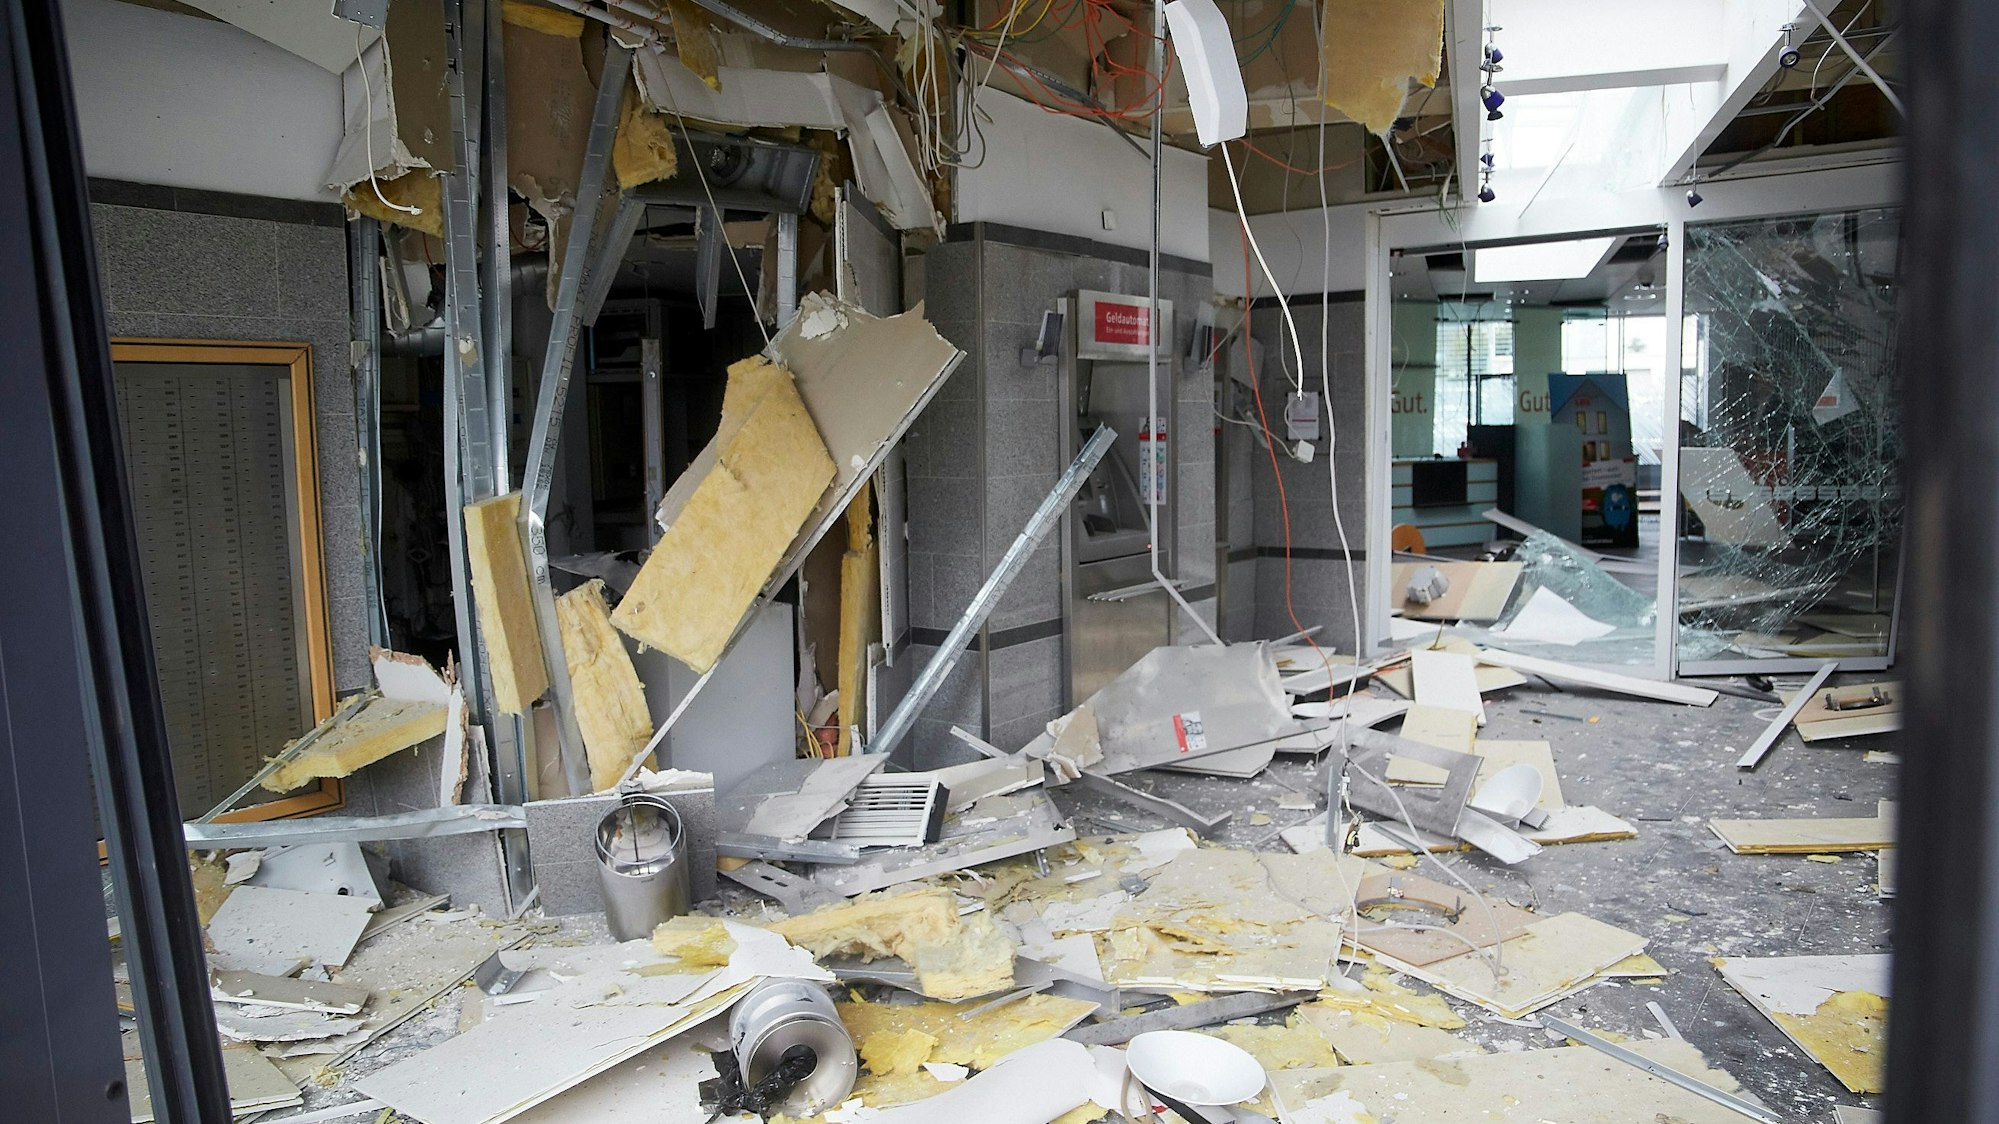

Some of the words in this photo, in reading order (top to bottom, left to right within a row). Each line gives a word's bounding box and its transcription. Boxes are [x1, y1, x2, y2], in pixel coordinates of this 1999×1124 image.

[576, 266, 591, 304] MAXI
[560, 315, 581, 373] PROFIL
[549, 386, 567, 426] 5215
[531, 526, 545, 555] 350
[536, 566, 546, 585] cm
[983, 578, 1010, 610] MAXI
